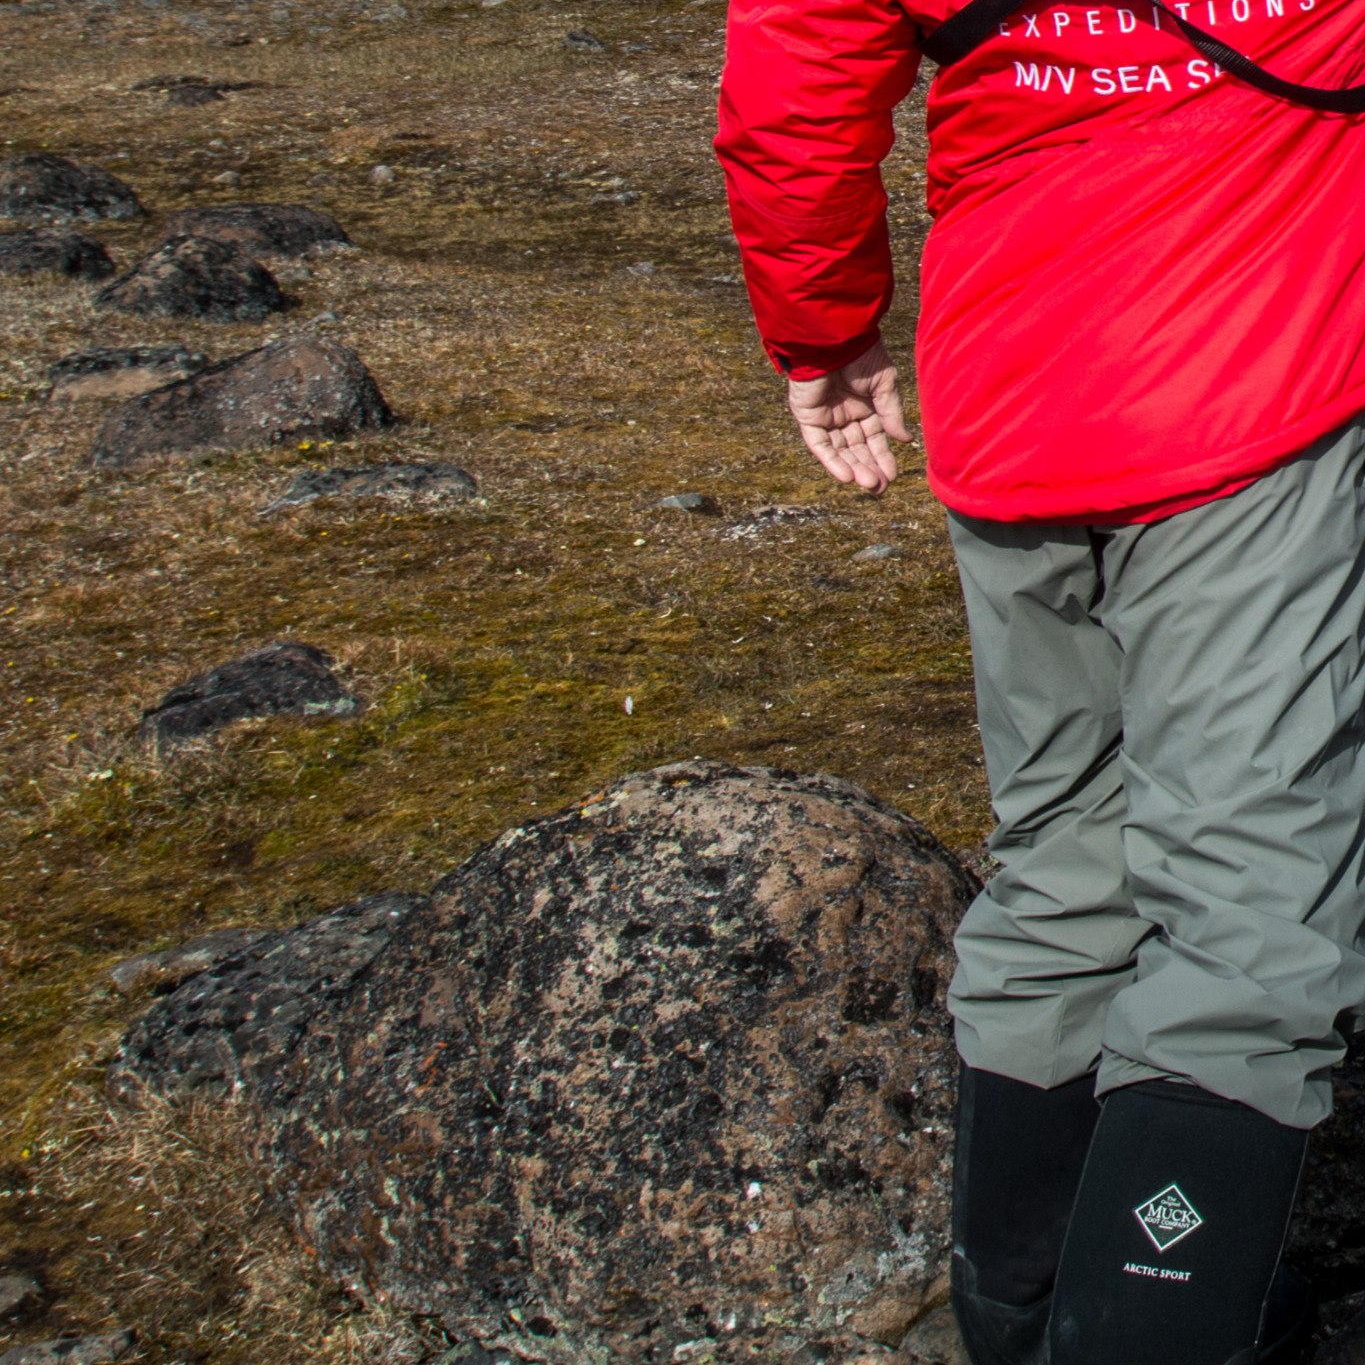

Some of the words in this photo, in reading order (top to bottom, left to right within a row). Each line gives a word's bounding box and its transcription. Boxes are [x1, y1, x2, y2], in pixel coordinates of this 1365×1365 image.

[1013, 61, 1075, 95] M/V
[1092, 64, 1172, 96] SEA
[1144, 1216, 1160, 1224] BOOT
[1160, 1219, 1190, 1229] COMPANY
[1147, 1203, 1193, 1224] MUCK
[1123, 1262, 1159, 1277] ARCTIC
[1160, 1269, 1192, 1282] SPORT
